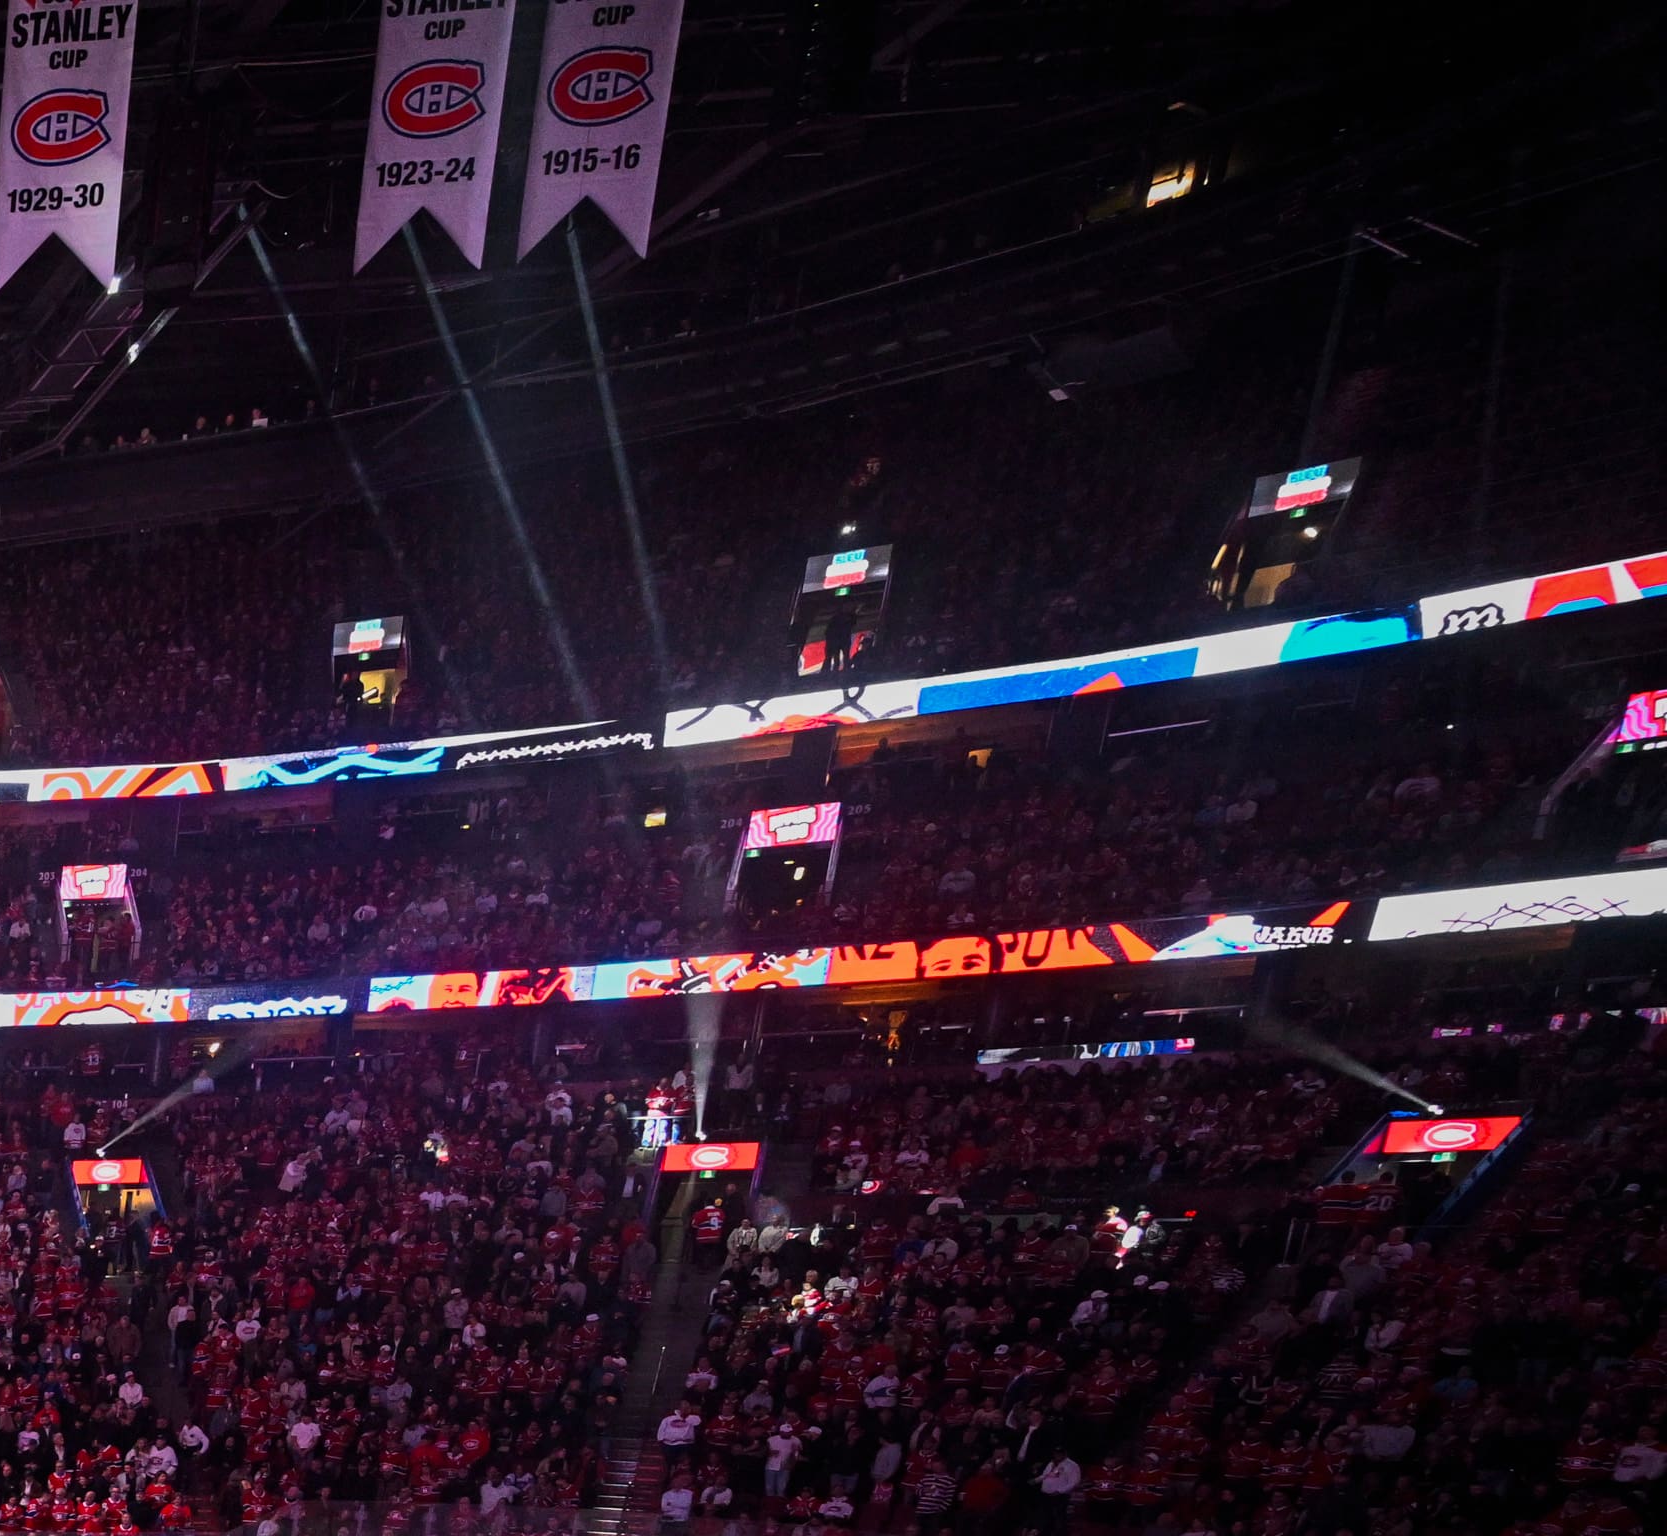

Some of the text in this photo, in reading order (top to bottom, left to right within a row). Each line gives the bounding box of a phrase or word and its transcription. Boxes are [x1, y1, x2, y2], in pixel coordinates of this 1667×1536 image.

[12, 5, 132, 48] STANLEY
[593, 7, 635, 26] CUP
[424, 20, 464, 40] CUP
[49, 50, 88, 69] CUP
[376, 157, 475, 187] 1923-24
[543, 145, 640, 175] 1915-16
[8, 183, 104, 212] 1929-30
[1254, 926, 1334, 943] JAKUB
